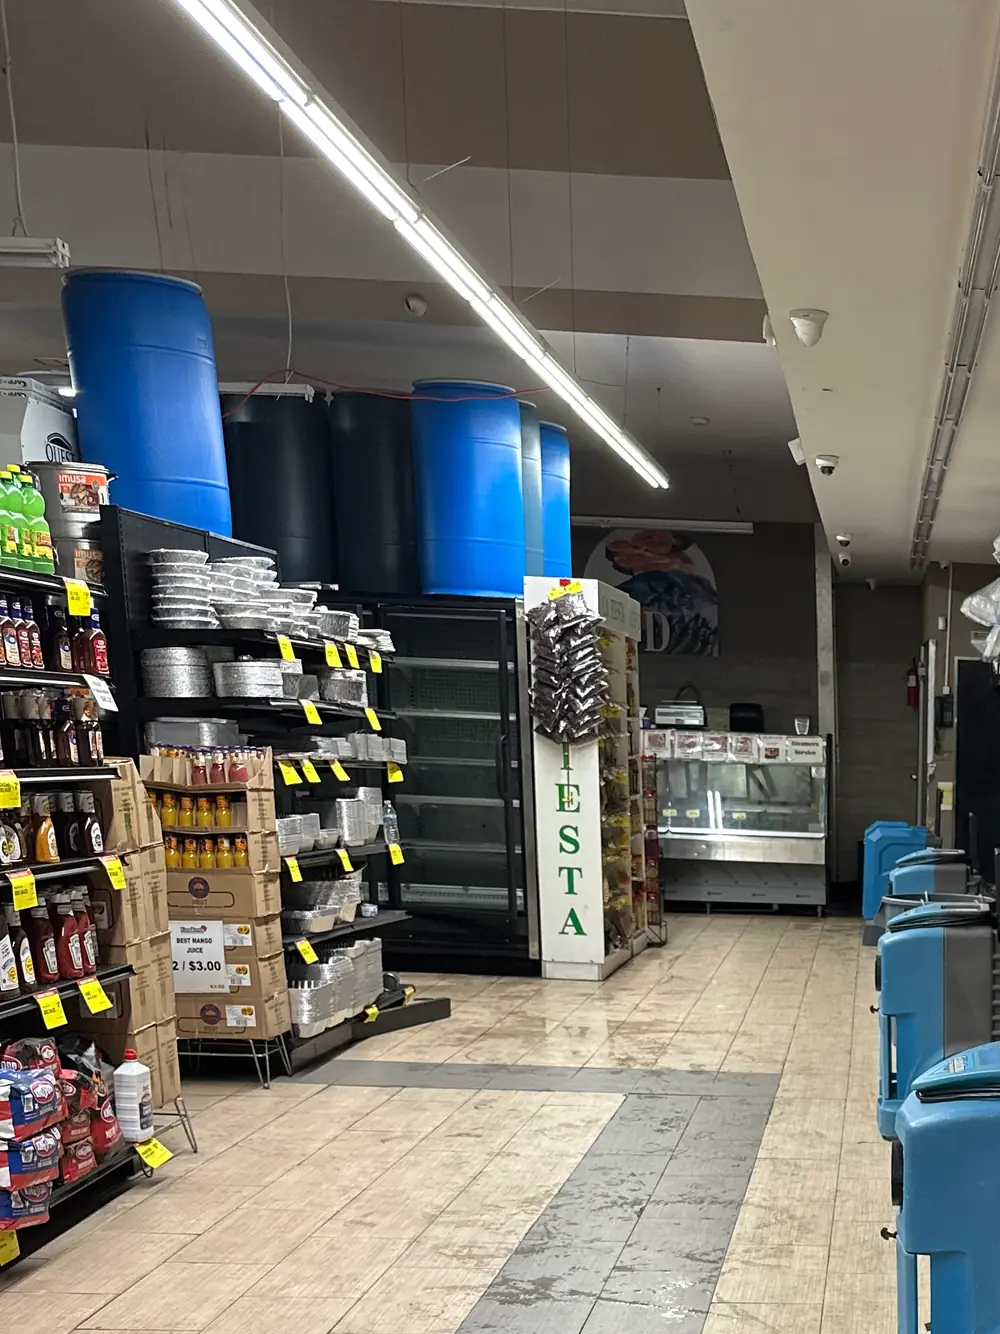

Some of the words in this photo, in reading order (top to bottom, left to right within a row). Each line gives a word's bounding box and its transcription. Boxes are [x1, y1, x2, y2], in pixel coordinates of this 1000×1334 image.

[554, 742, 588, 937] IESTA
[172, 960, 179, 971] 2
[189, 960, 222, 972] $3.00
